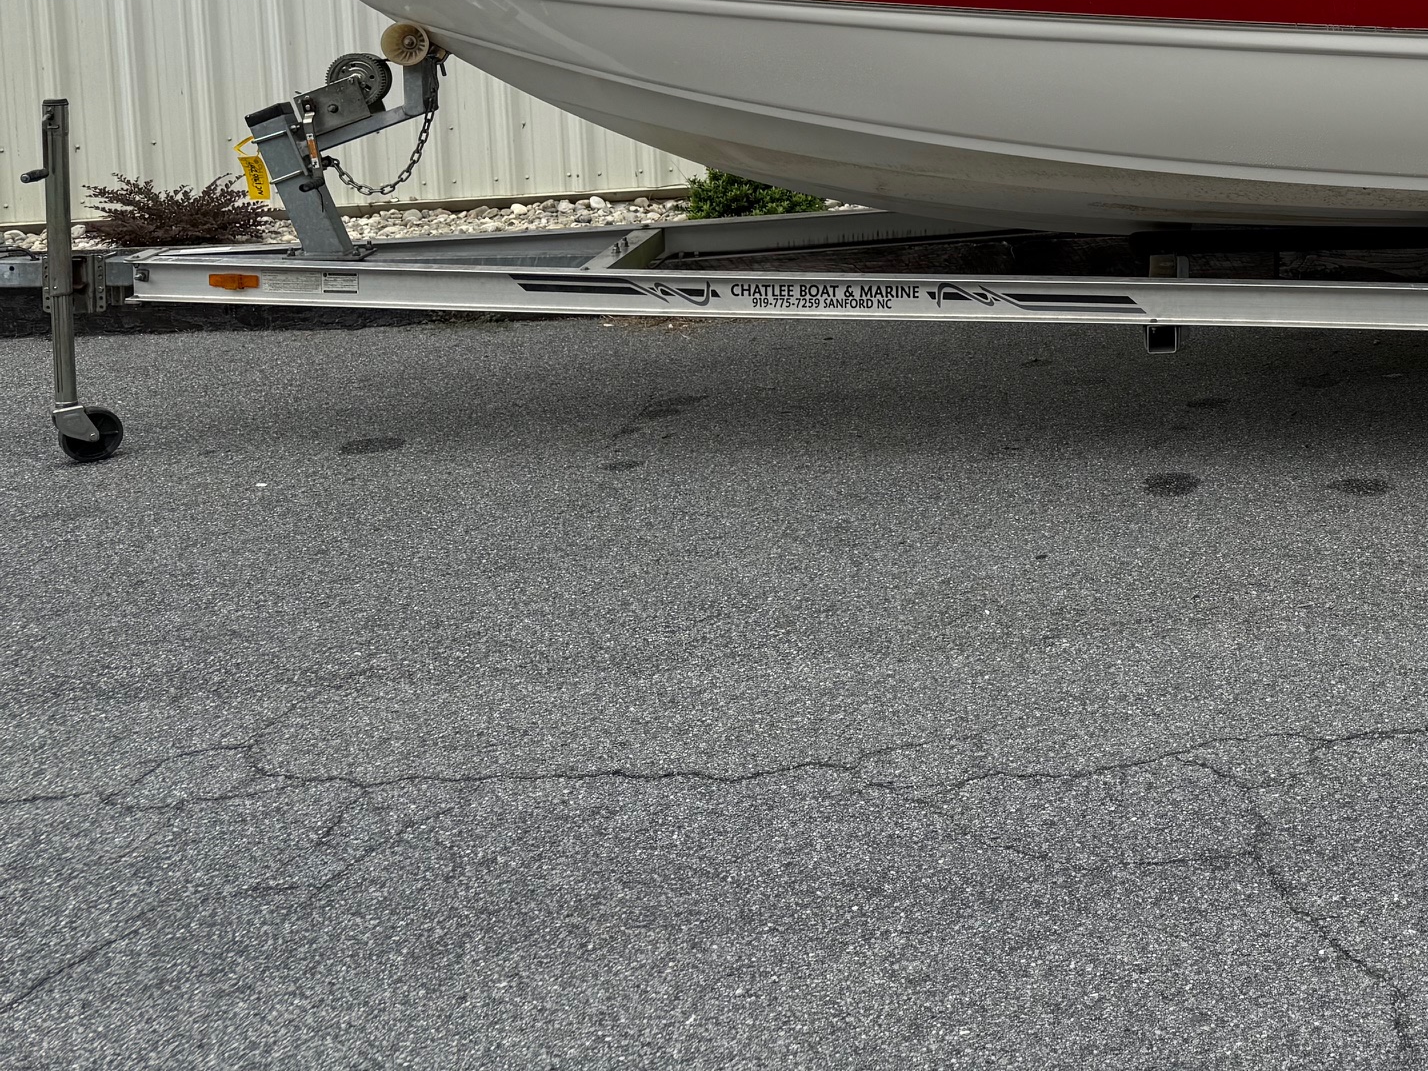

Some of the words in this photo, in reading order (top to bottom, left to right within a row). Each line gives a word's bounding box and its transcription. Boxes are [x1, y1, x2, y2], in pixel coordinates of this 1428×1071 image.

[731, 283, 794, 297] CHATLEE
[799, 285, 838, 298] BOAT
[843, 286, 855, 299] &
[859, 286, 920, 300] MARINE
[752, 297, 820, 309] 919-775-7259
[823, 298, 874, 310] SANFORD
[876, 298, 893, 310] NC
